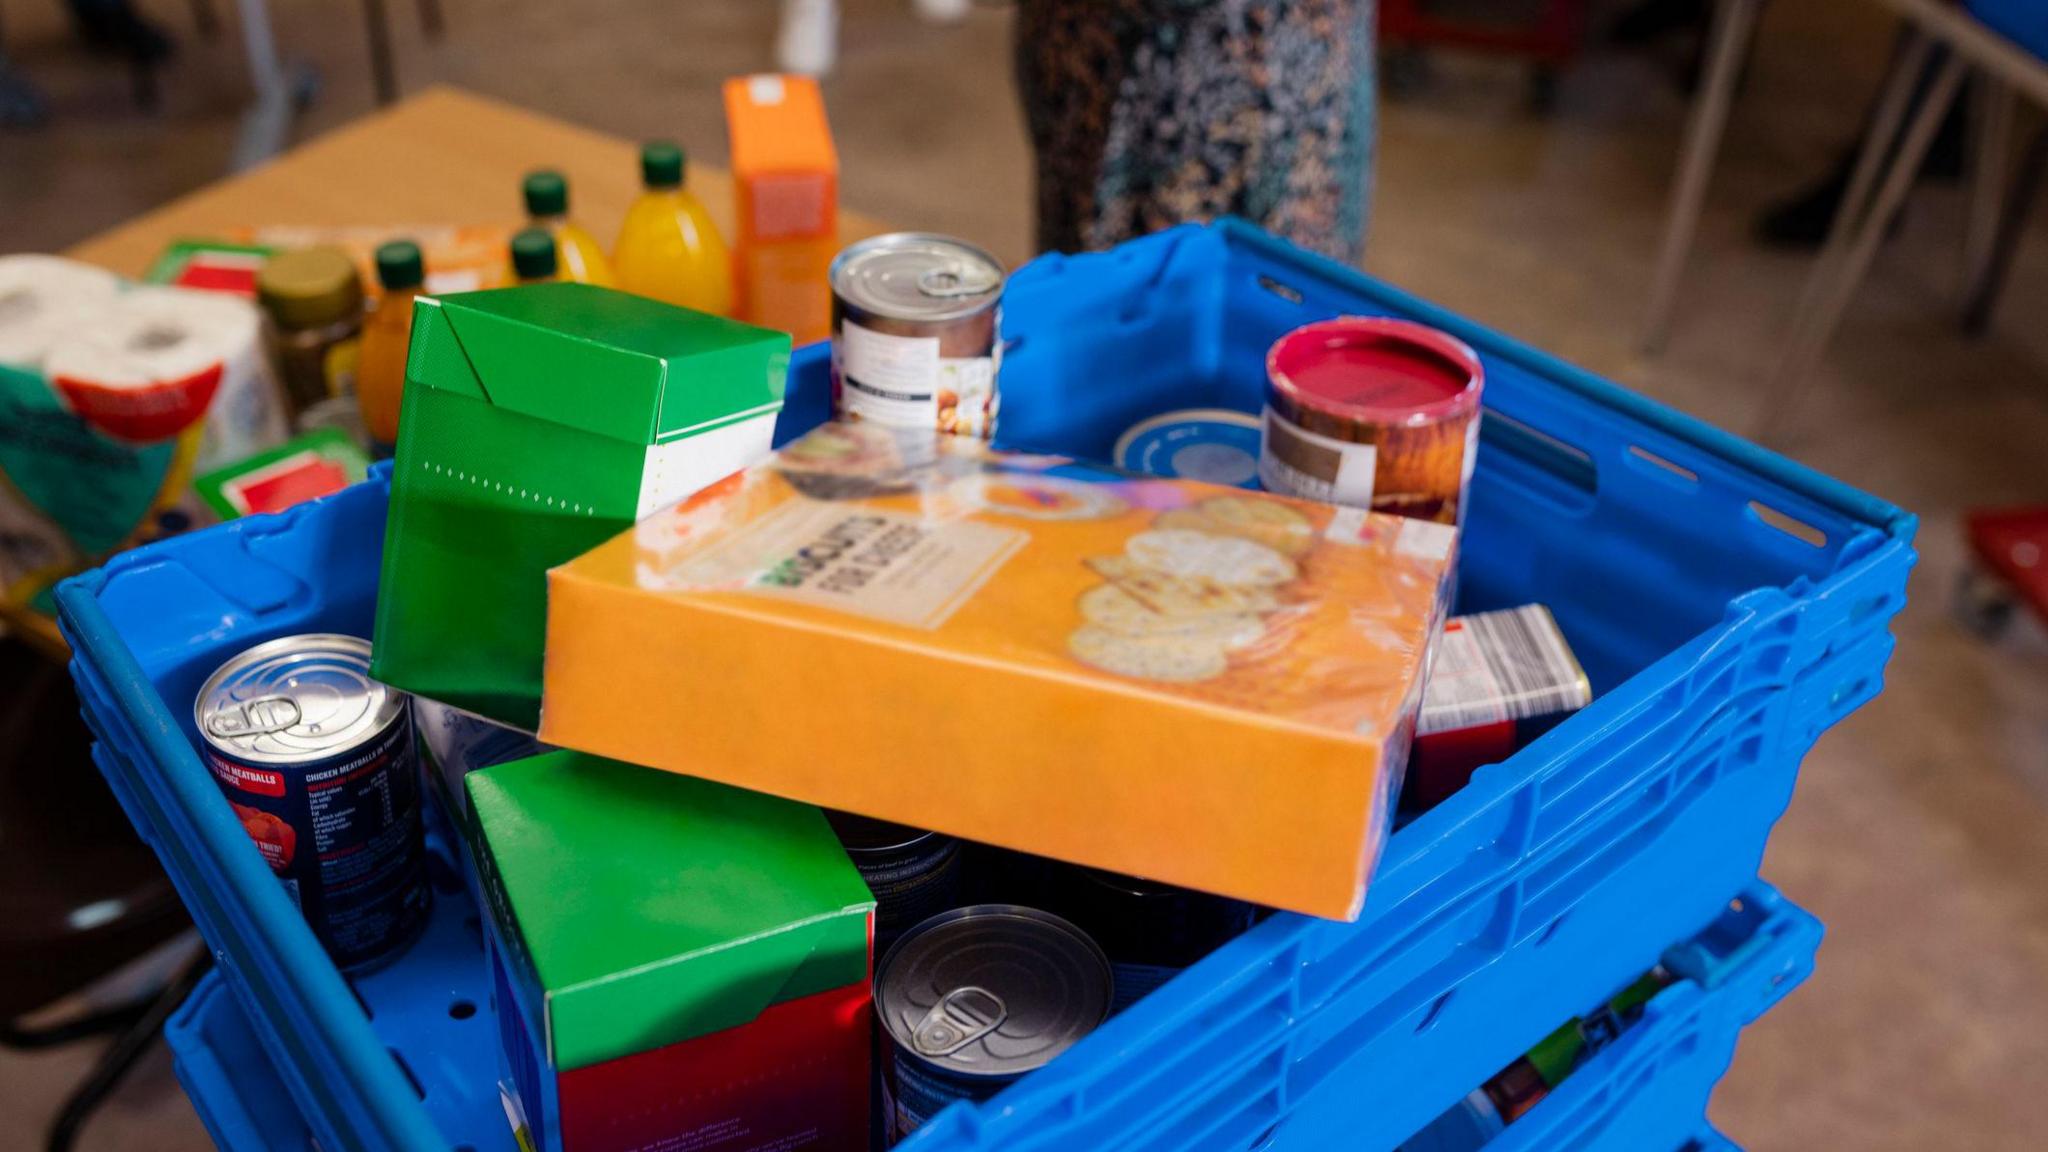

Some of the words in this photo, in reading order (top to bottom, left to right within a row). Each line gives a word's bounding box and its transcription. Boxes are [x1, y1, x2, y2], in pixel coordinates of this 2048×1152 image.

[760, 515, 887, 588] BISCUITS
[817, 565, 876, 594] FOR
[852, 523, 923, 567] CHEESE
[305, 768, 339, 783] CHICKEN
[339, 750, 377, 775] MEATBALLS
[219, 769, 241, 787] SAUCE
[231, 767, 276, 785] MEATBALLS
[308, 789, 327, 799] Typical
[327, 786, 343, 795] values
[863, 872, 898, 882] HEATING
[698, 1116, 741, 1133] difference
